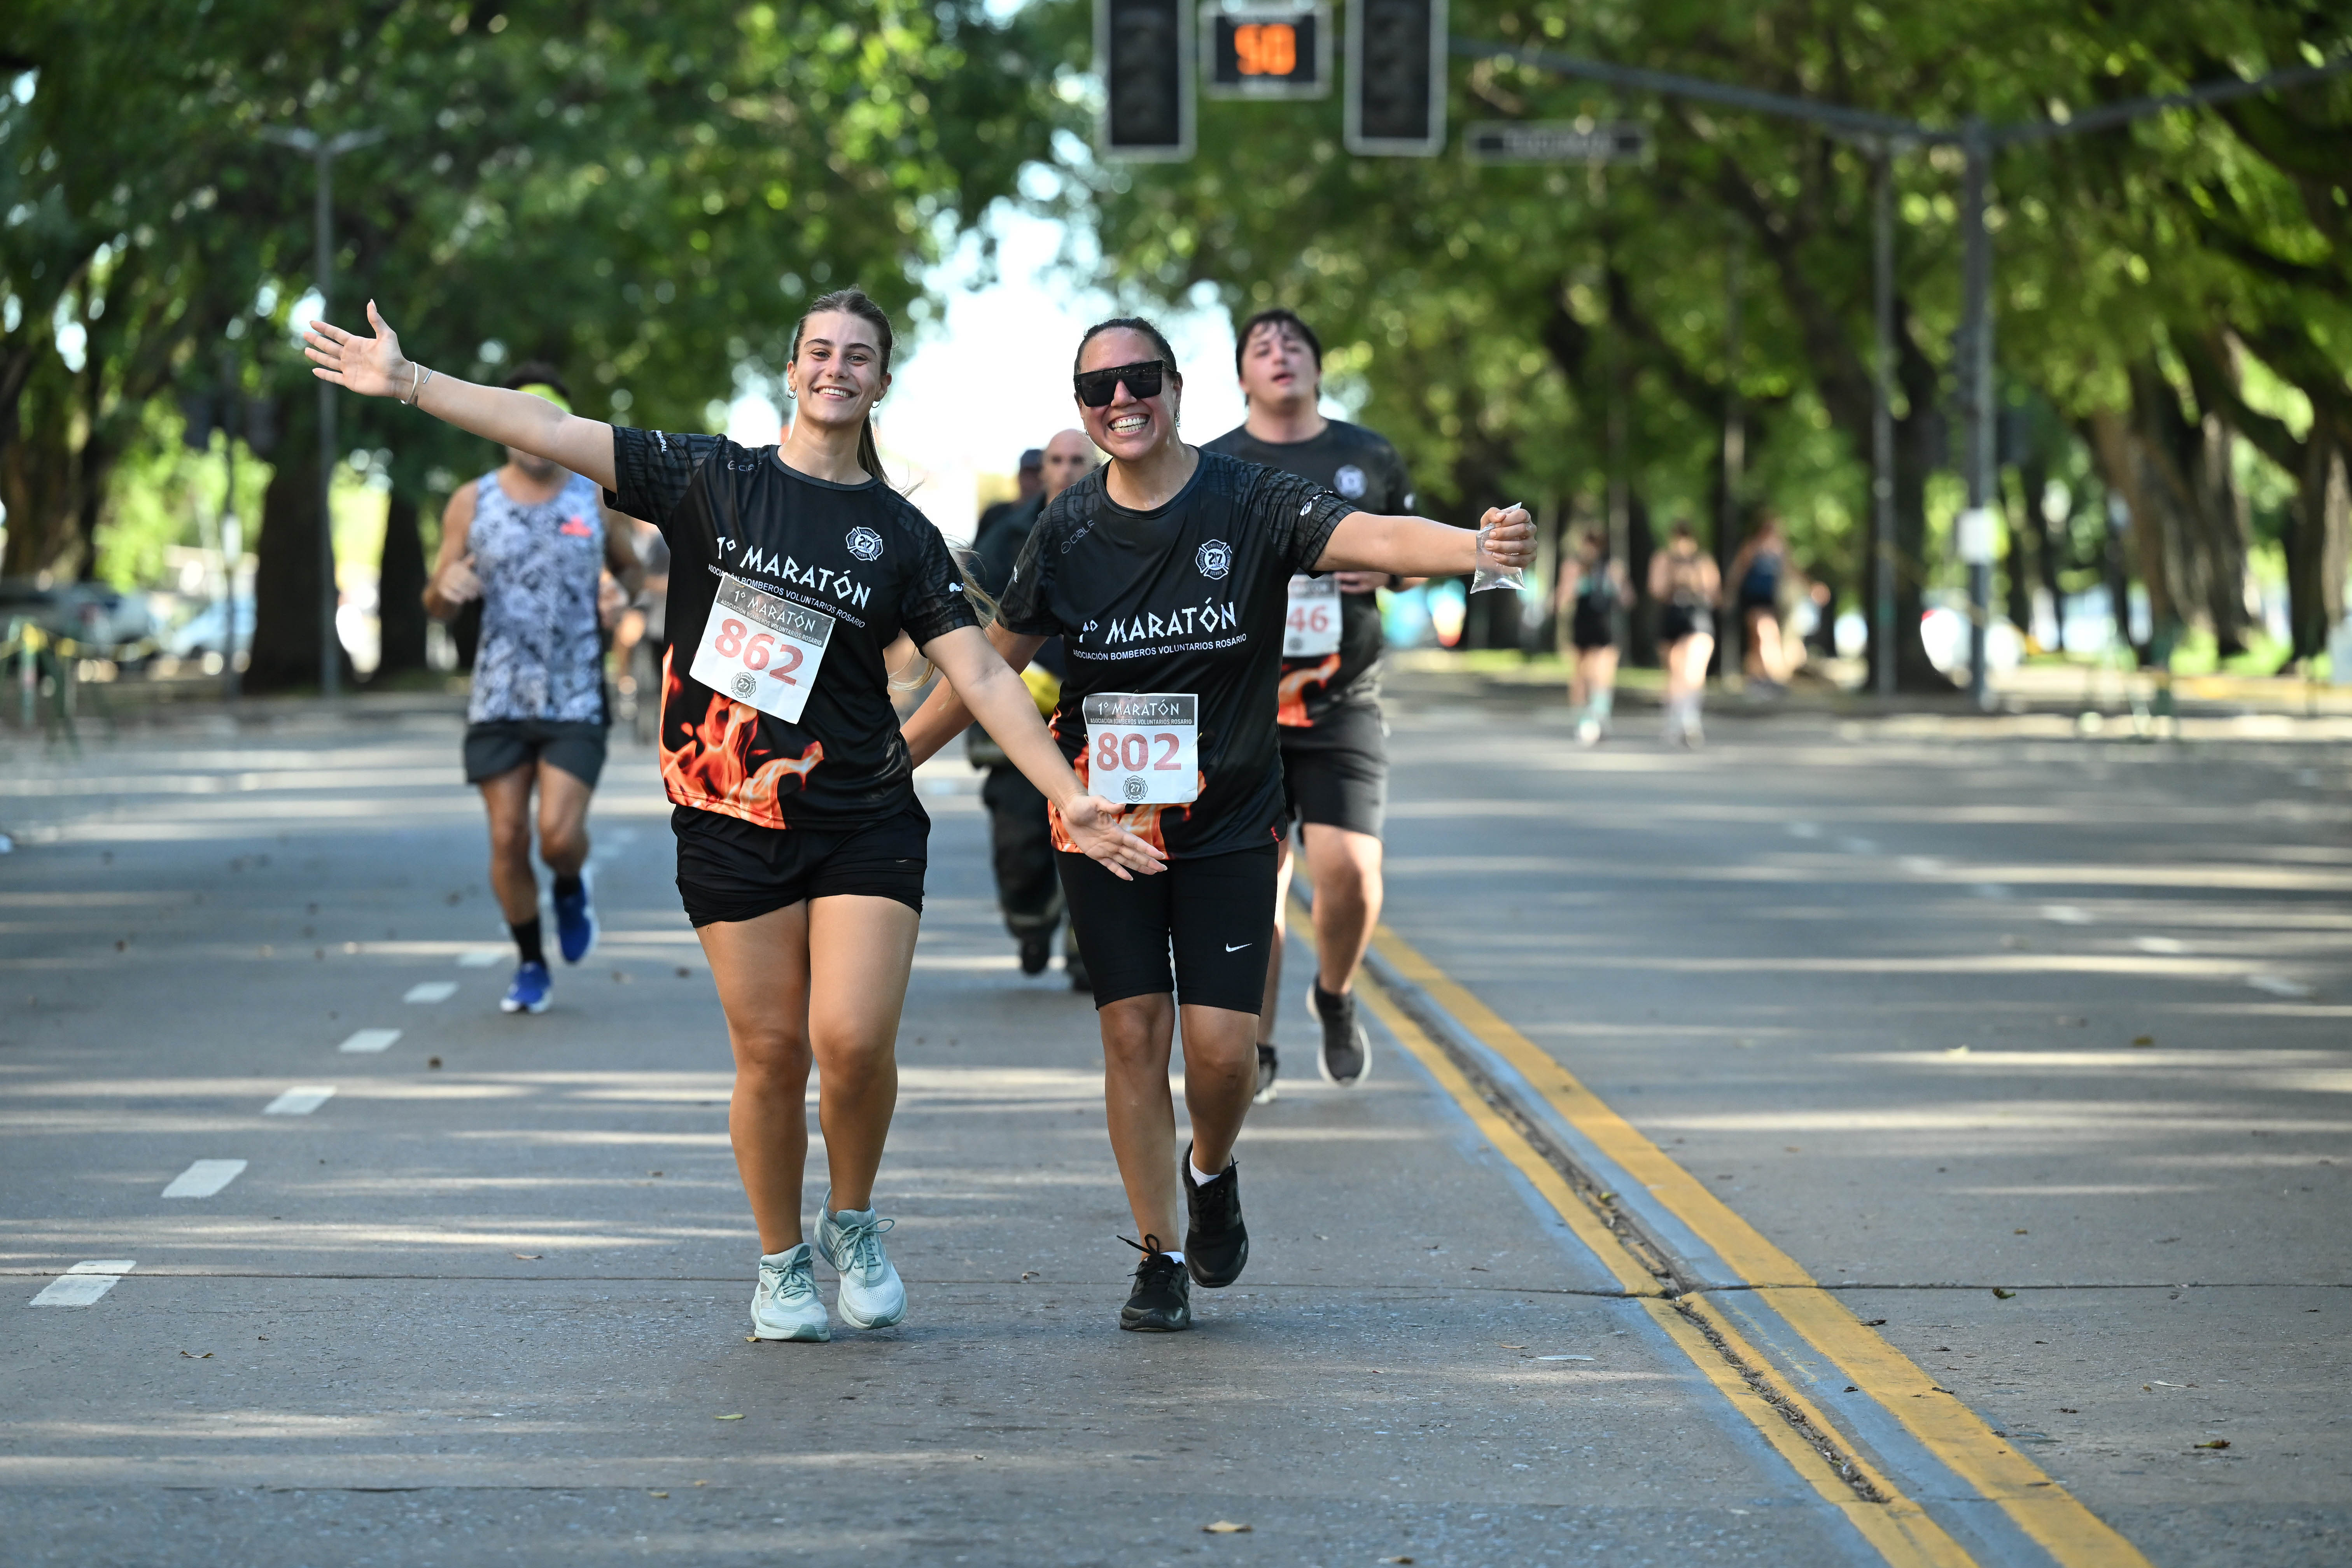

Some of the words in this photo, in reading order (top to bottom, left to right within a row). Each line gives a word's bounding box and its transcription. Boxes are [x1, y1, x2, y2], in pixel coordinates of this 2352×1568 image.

[858, 536, 873, 549] 27
[1208, 552, 1223, 565] 27
[739, 545, 871, 610] MARATÓN
[741, 577, 784, 596] BOMBEROS
[786, 589, 836, 614] VOLUNTARIOS
[836, 606, 866, 628] ROSARIO
[747, 597, 816, 634] MARATÓN
[1105, 597, 1236, 644] MARATÓN
[720, 599, 746, 616] ASOCIACIÓN
[746, 611, 770, 626] BOMBEROS
[770, 622, 802, 639] VOLUNTARIOS
[802, 634, 822, 646] ROSARIO
[715, 618, 803, 686] 862
[1073, 649, 1109, 660] ASOCIACIÓN
[1111, 647, 1157, 660] BOMBEROS
[1158, 642, 1214, 654] VOLUNTARIOS
[1216, 633, 1247, 648] ROSARIO
[1111, 699, 1180, 716] MARATÓN
[1096, 732, 1181, 772] 802
[1130, 783, 1140, 793] 27
